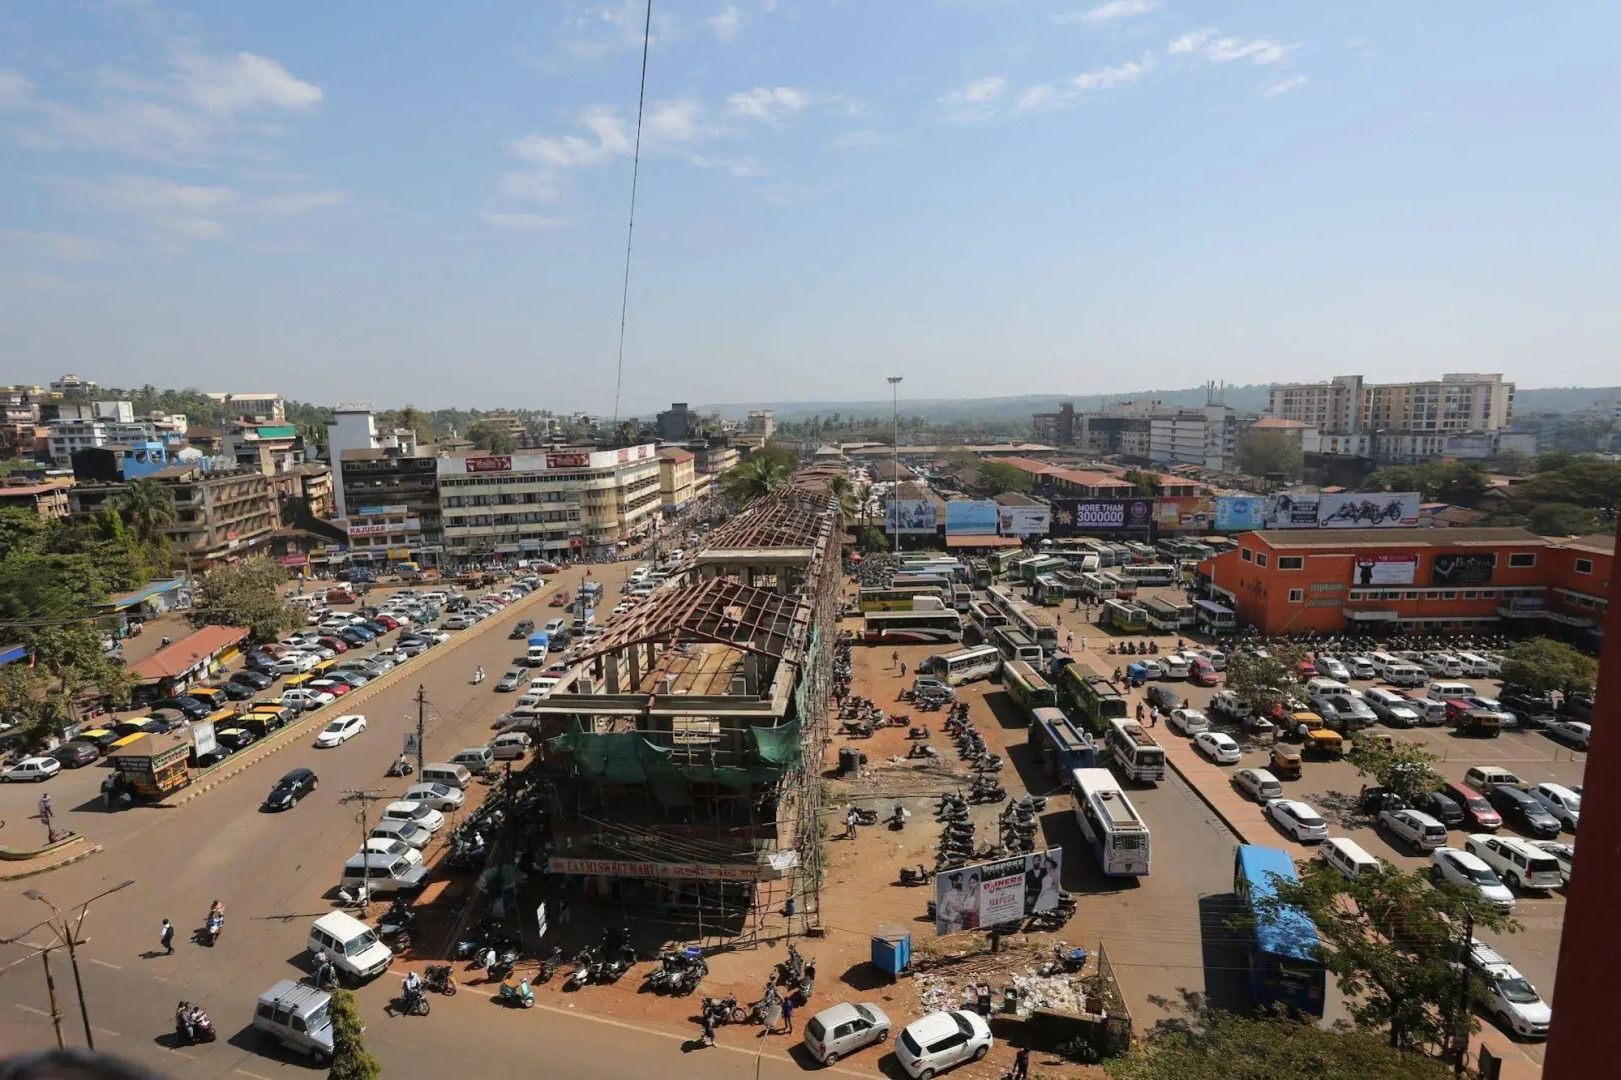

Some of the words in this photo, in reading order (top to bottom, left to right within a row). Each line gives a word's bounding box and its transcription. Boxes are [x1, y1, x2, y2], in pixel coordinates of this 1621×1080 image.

[1077, 504, 1100, 512] MORE
[1101, 504, 1124, 512] THAN
[1077, 512, 1124, 521] 3000000
[350, 526, 385, 534] KAJUGAR
[567, 860, 597, 873] LAXMI
[599, 861, 627, 874] SWEET
[629, 862, 654, 875] MART
